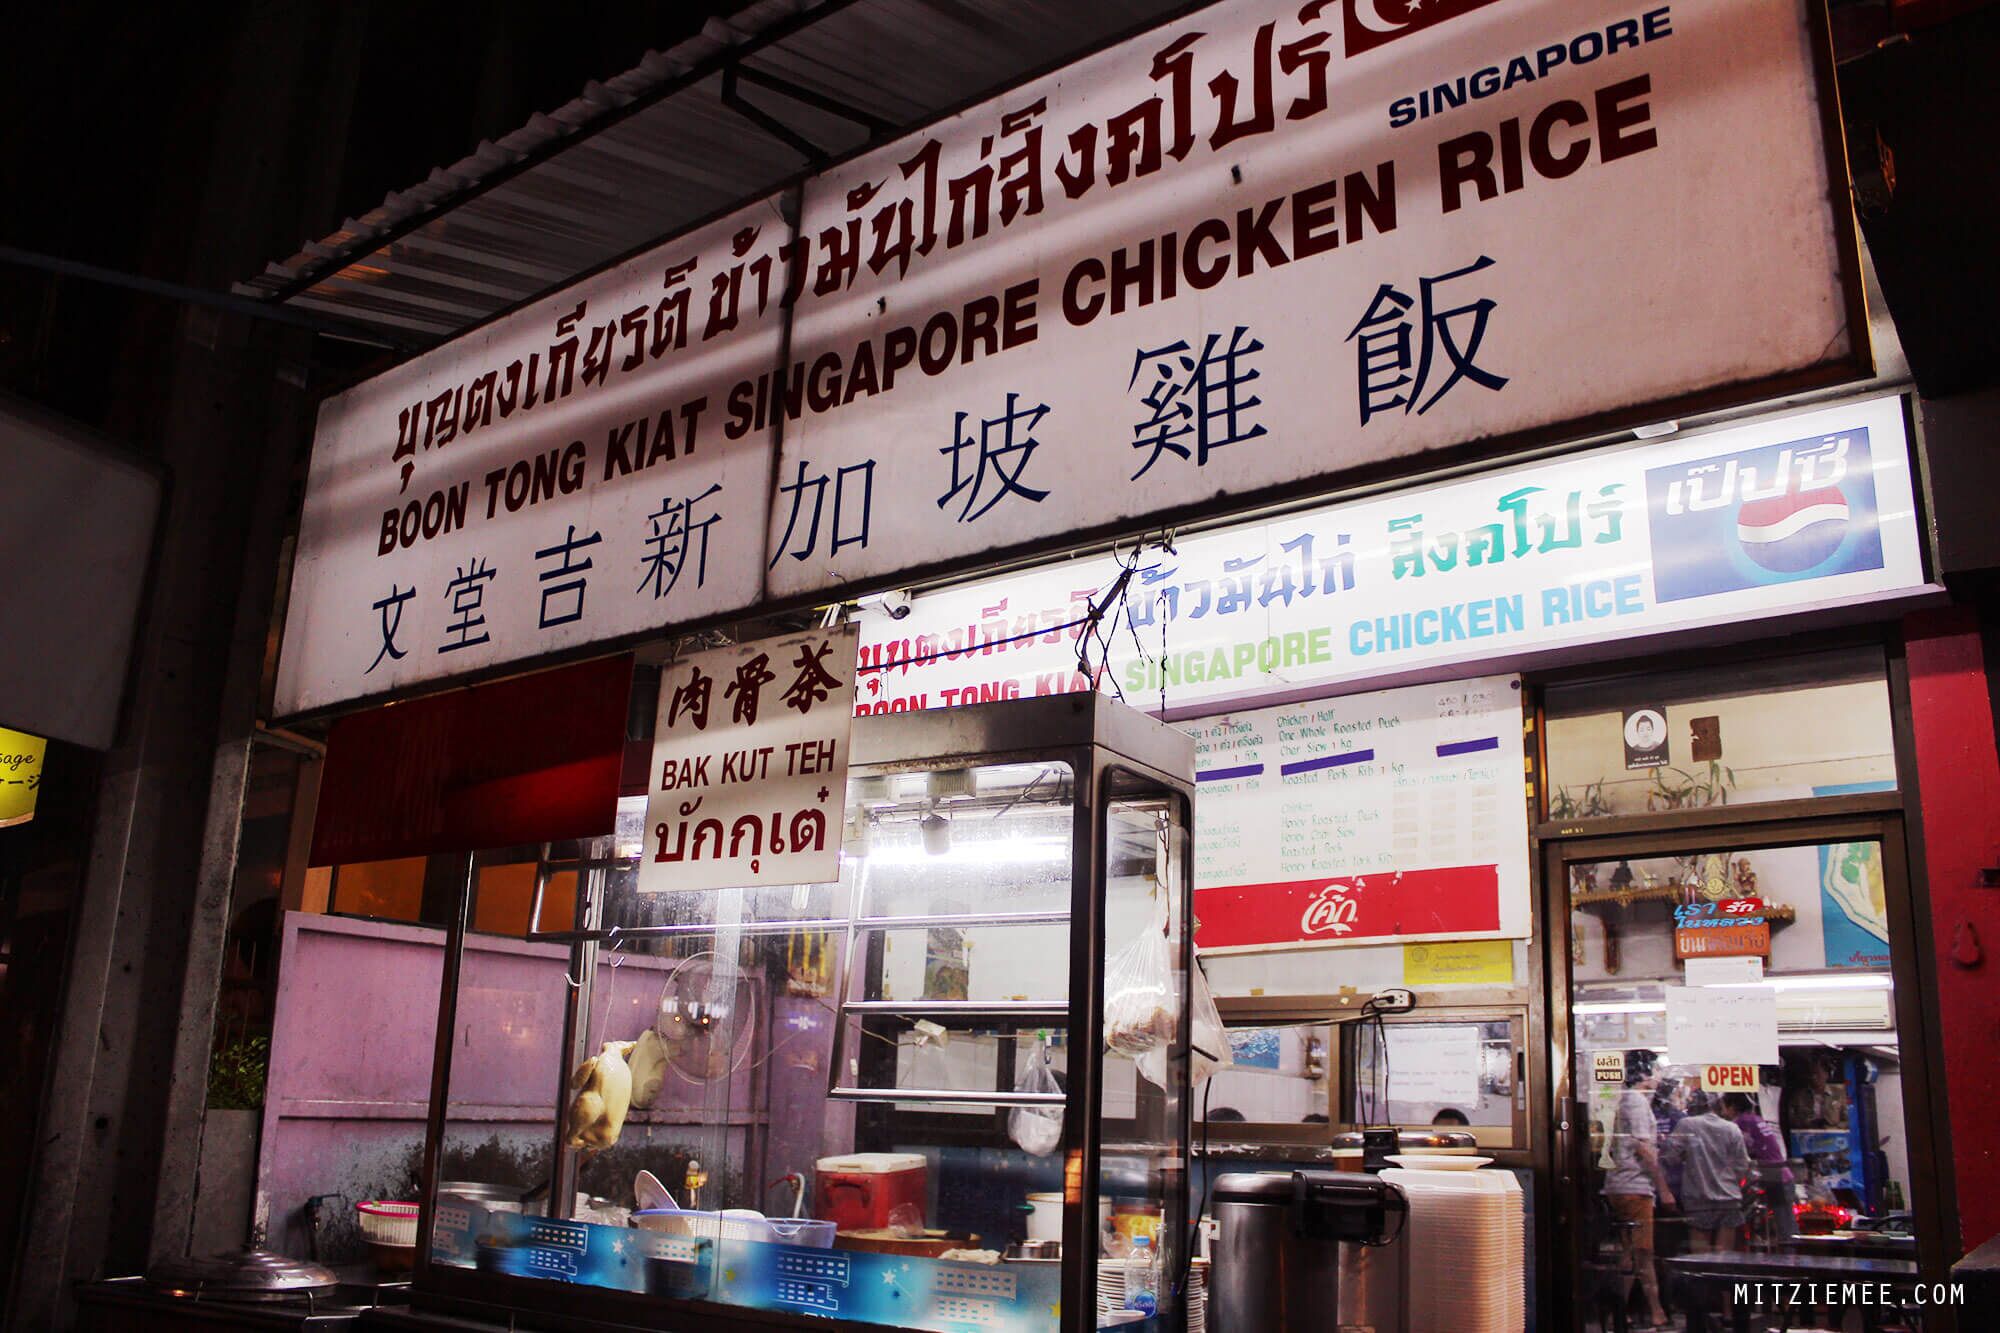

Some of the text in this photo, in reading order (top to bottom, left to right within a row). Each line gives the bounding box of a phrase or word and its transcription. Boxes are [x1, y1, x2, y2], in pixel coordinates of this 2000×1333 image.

[1389, 6, 1672, 128] SINGAPORE
[378, 73, 1658, 556] BOON TONG KIAT SINGAPORE CHICKEN RICE
[1125, 627, 1332, 692] SINGAPORE
[1350, 594, 1524, 656] CHICKEN
[1541, 574, 1645, 627] RICE
[667, 640, 843, 730] 肉骨茶
[661, 739, 836, 791] BAK KUT TEH
[655, 786, 830, 873] บักกุเต๋
[1597, 1071, 1622, 1081] PUSH
[1707, 1065, 1753, 1087] OPEN
